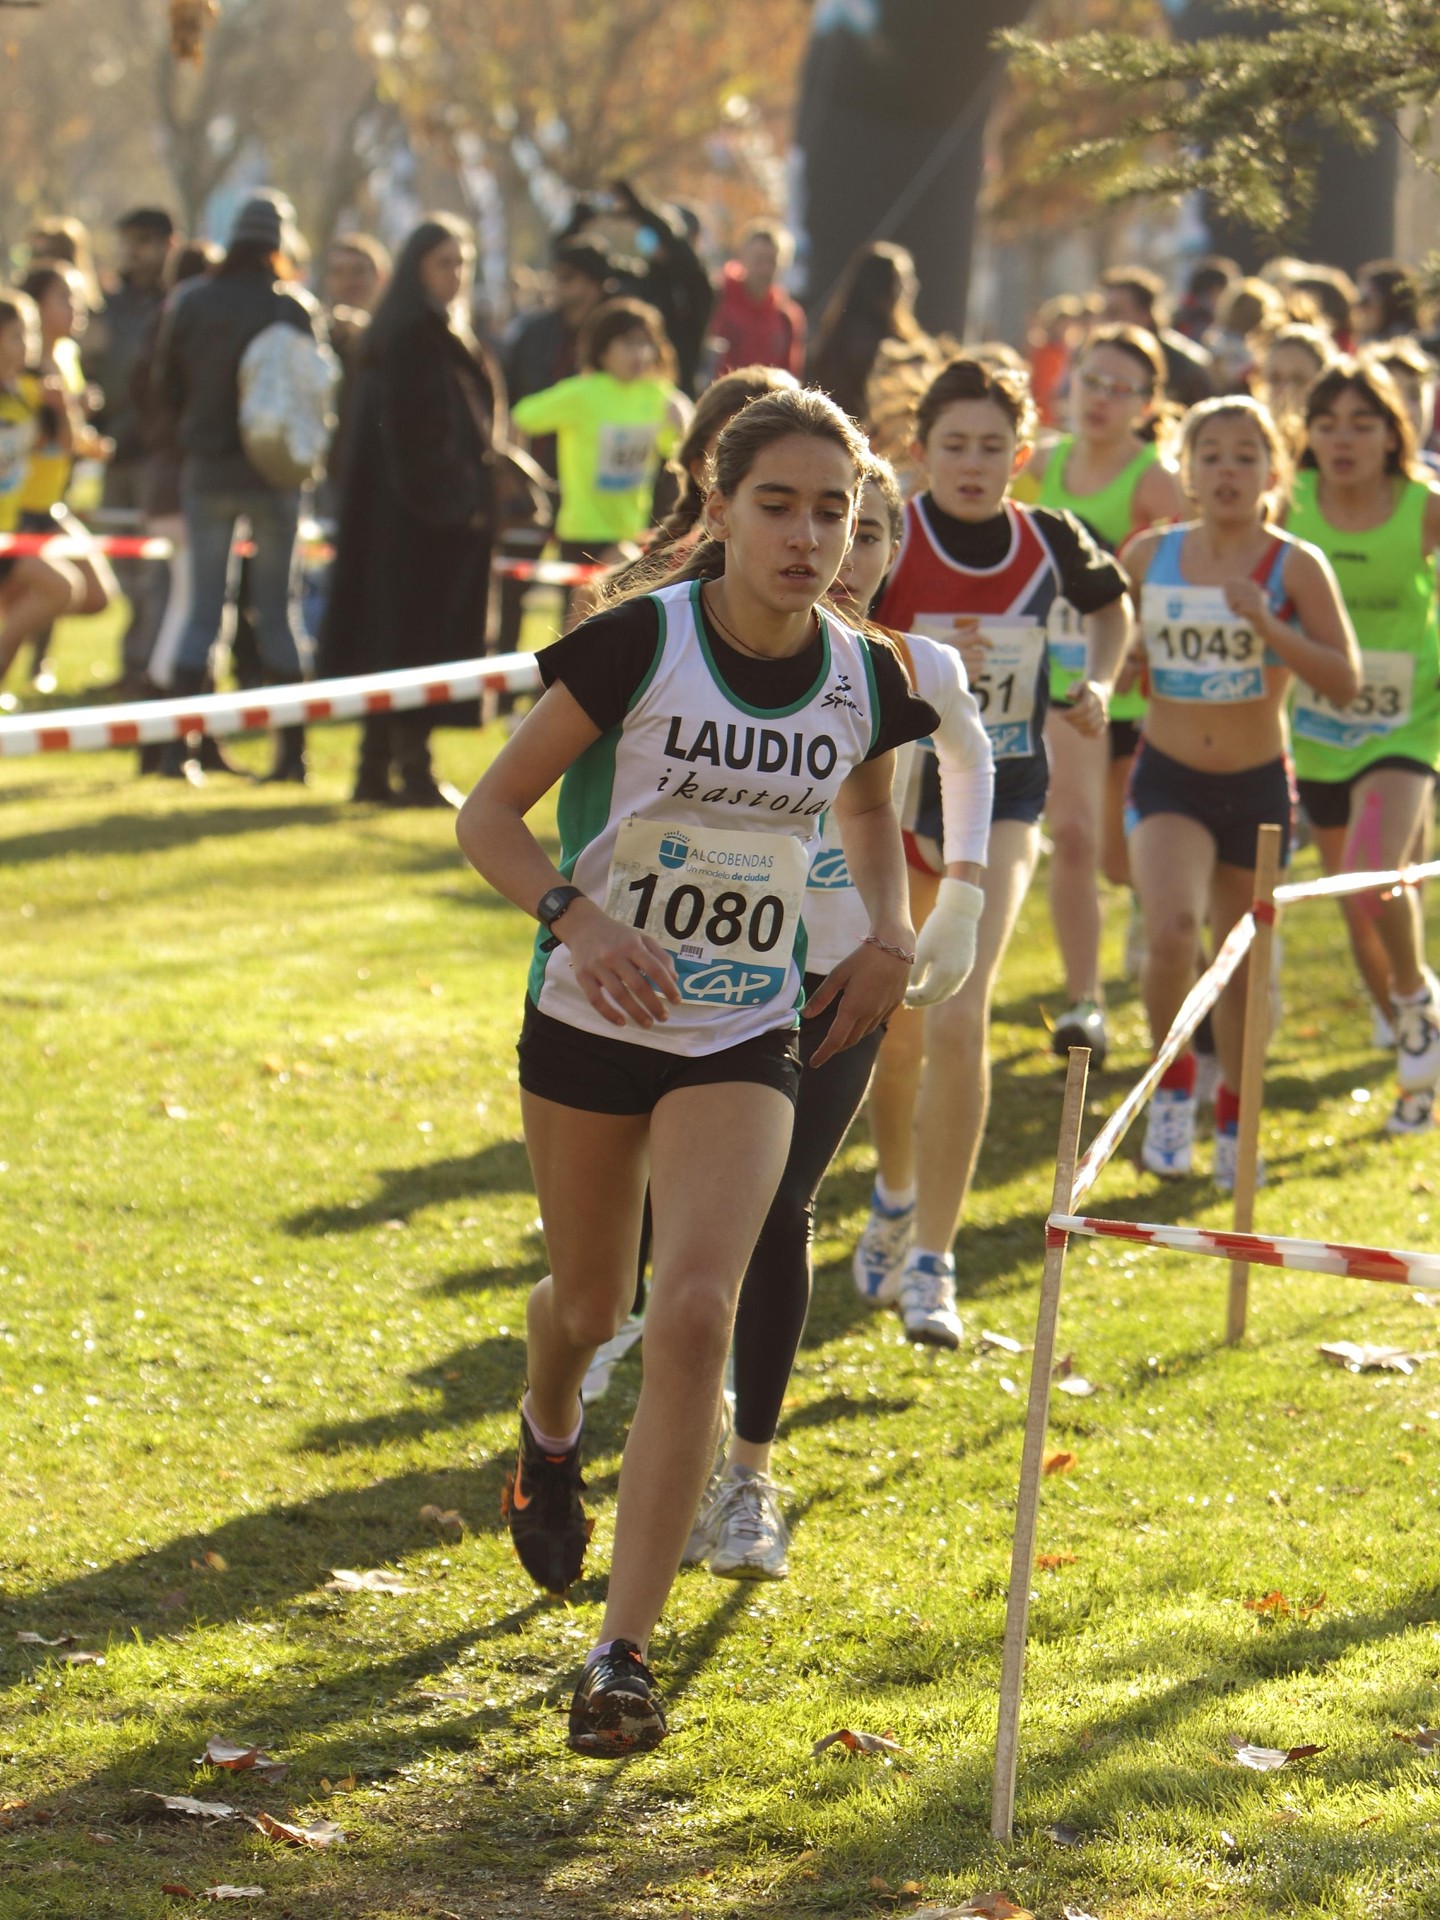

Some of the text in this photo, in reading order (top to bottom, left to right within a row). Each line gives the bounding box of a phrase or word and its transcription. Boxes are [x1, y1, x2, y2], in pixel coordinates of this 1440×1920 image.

[1157, 626, 1253, 662] 1043
[663, 715, 838, 781] LAUDIO
[656, 767, 831, 816] ikastola
[685, 863, 771, 882] Un modelo de ciudad
[689, 848, 775, 869] ALCOBENDAS
[809, 853, 853, 887] CA
[628, 872, 785, 953] 1080
